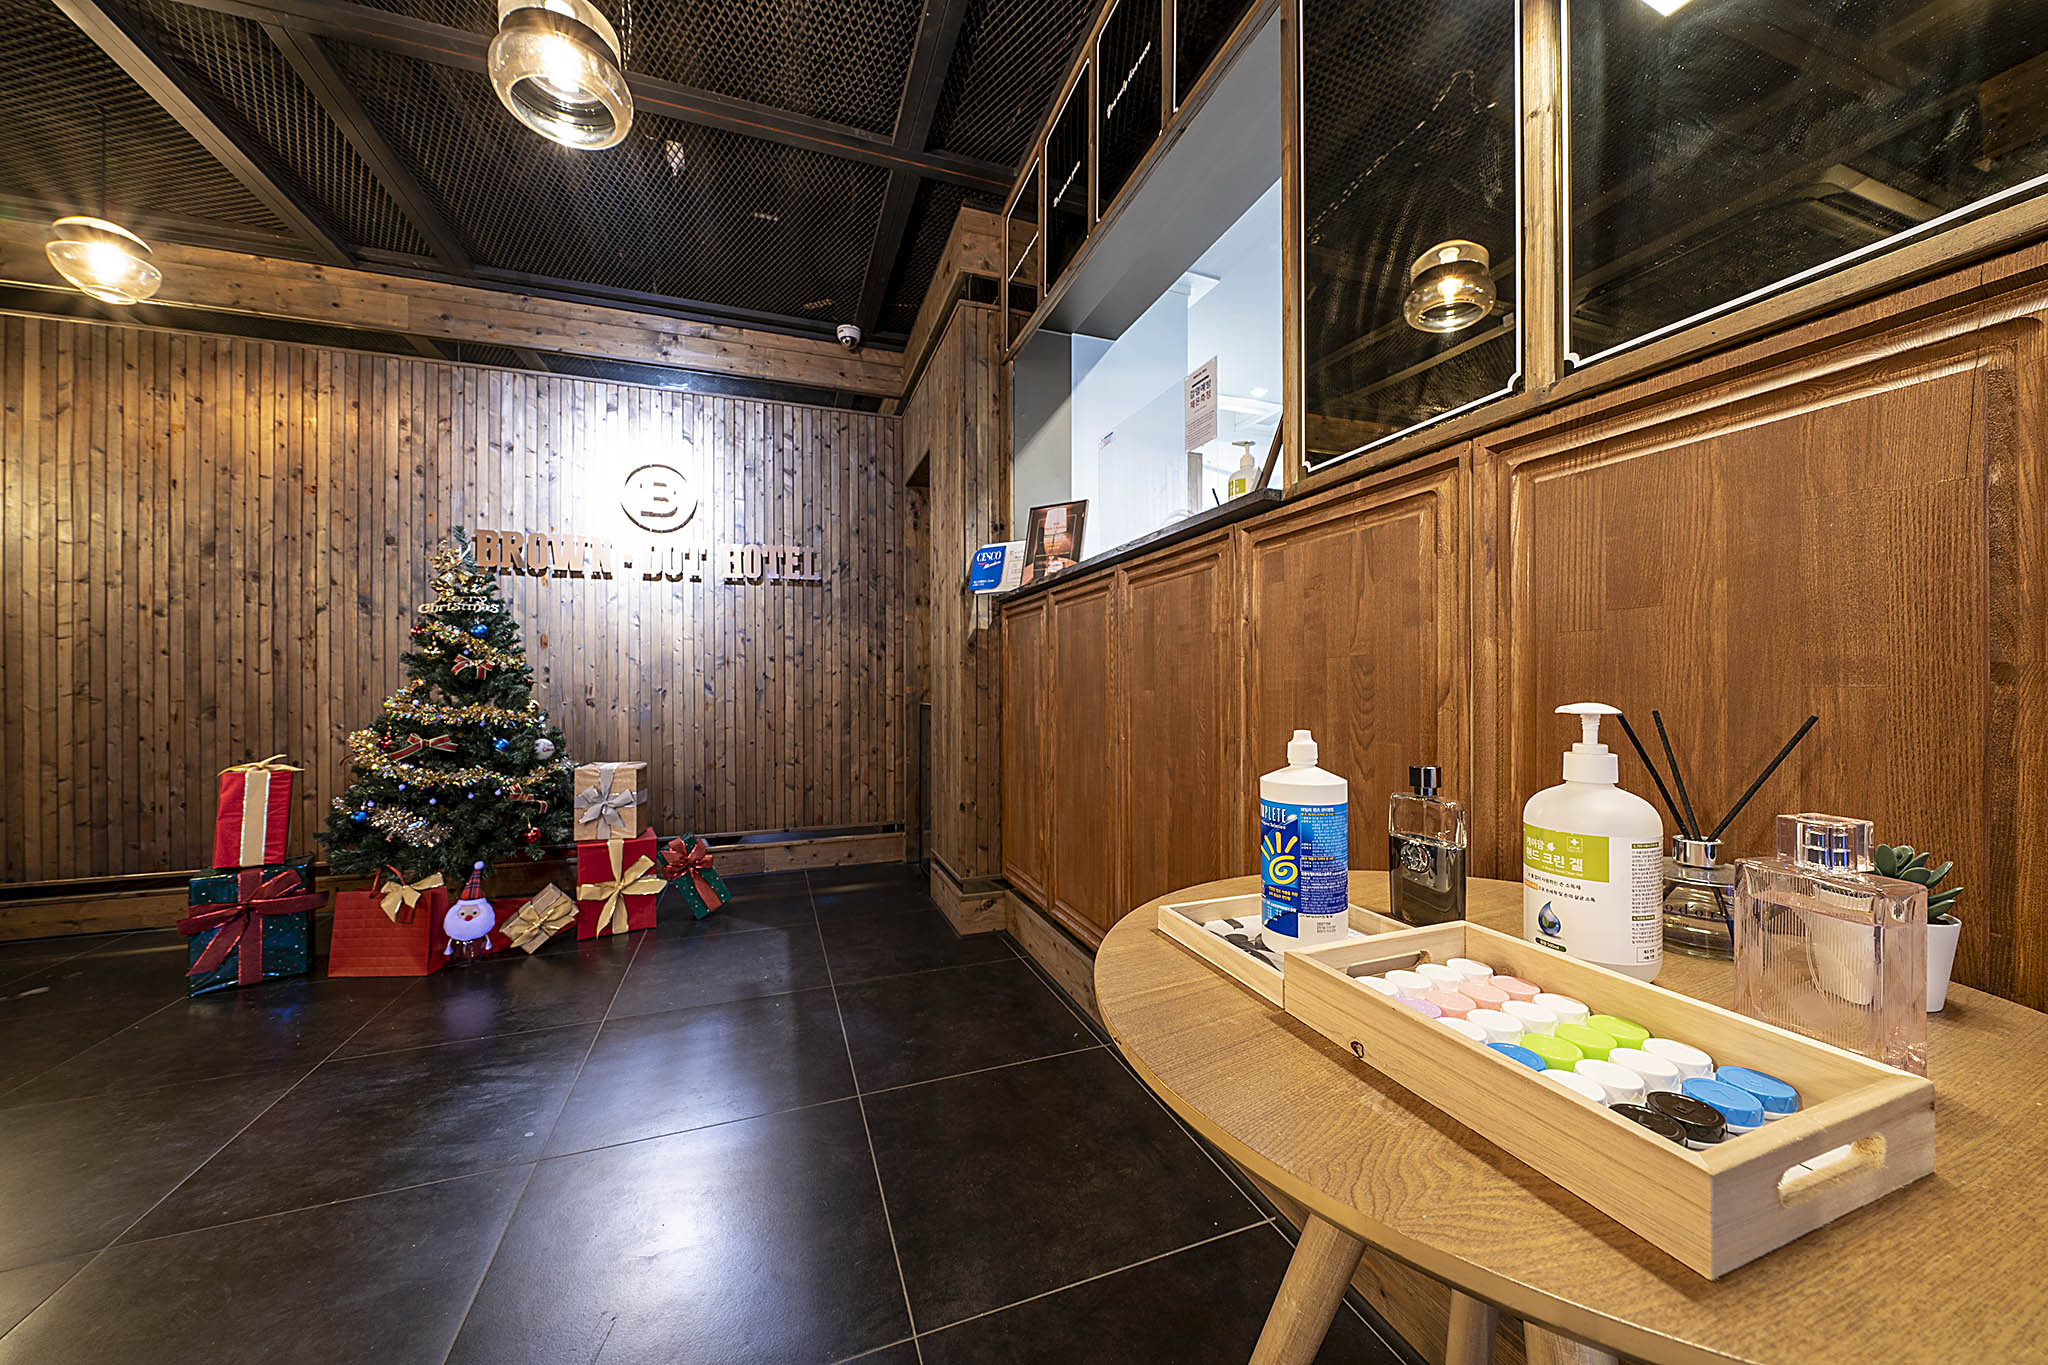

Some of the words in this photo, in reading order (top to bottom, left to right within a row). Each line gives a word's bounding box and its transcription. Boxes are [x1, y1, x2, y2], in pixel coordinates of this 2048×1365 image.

[474, 528, 613, 580] BROWN
[723, 543, 823, 585] HOTEL
[976, 550, 1002, 562] CESCO
[417, 602, 500, 614] Christmas
[1542, 852, 1565, 869] 크린
[1569, 857, 1584, 872] 겔
